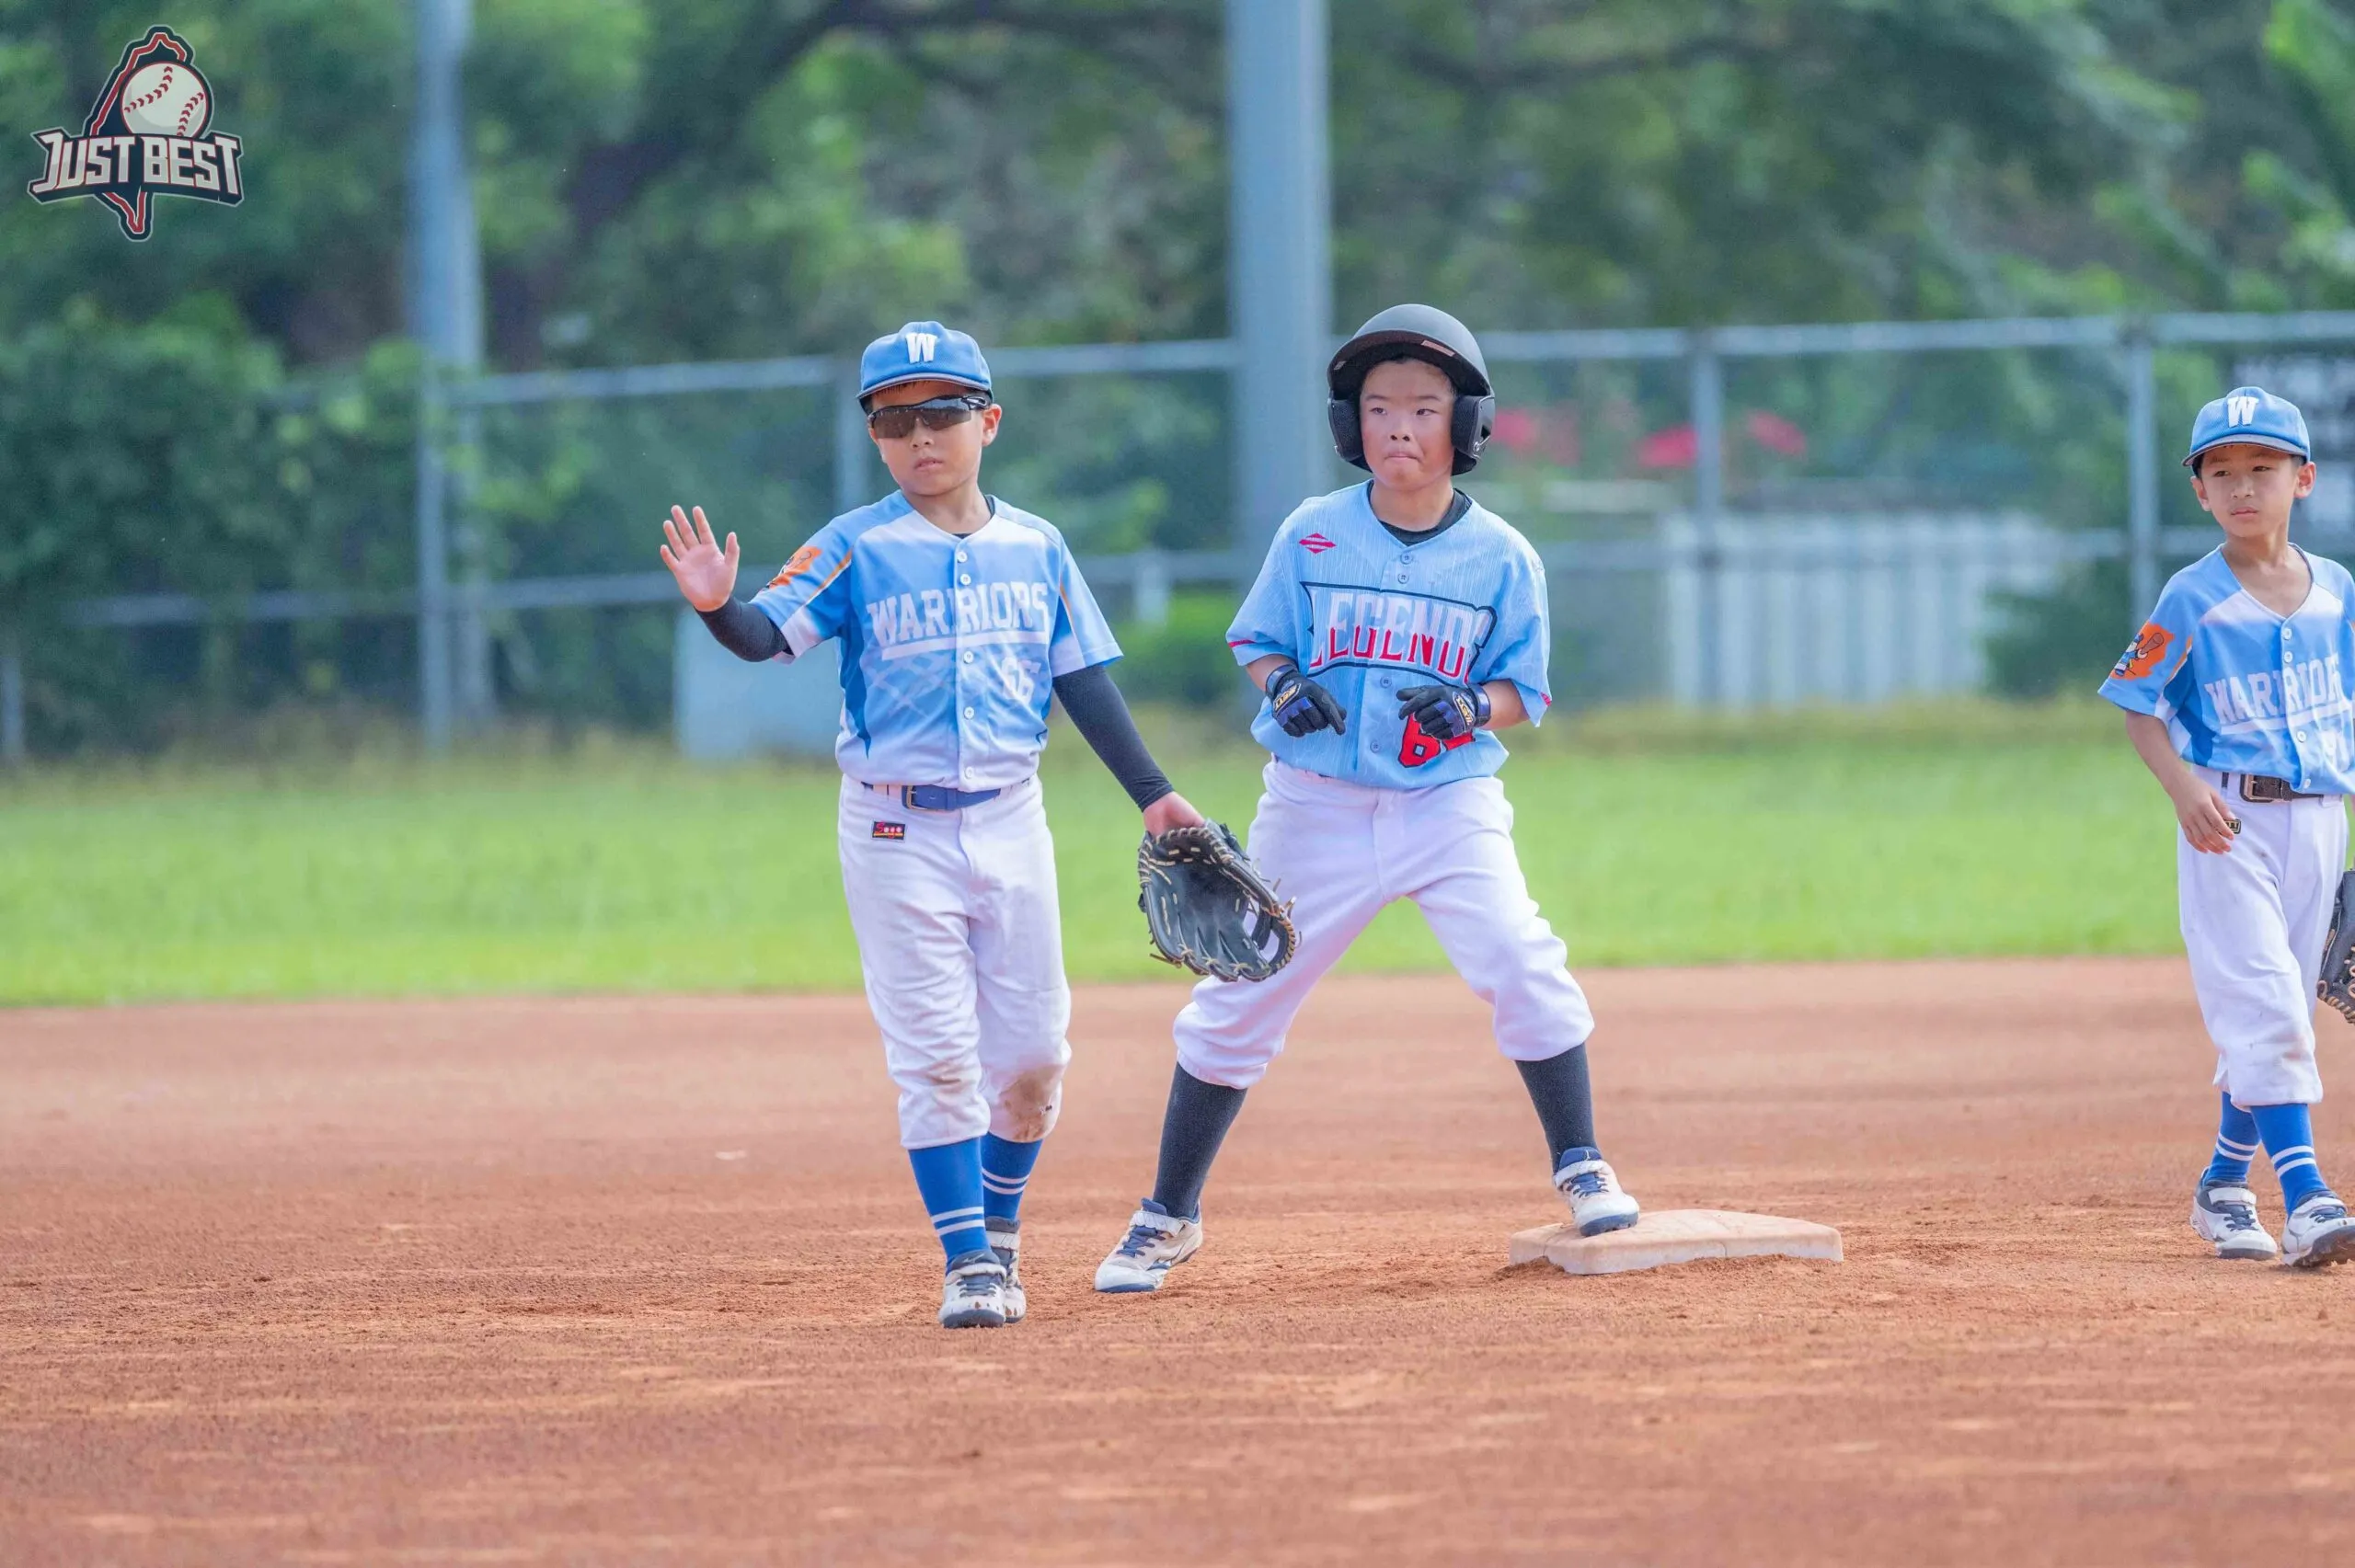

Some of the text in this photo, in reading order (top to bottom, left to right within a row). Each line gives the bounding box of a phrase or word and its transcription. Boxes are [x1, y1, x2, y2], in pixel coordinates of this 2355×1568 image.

[905, 332, 937, 364] W
[2227, 395, 2259, 429] W
[866, 581, 1049, 648] WARRIORS
[2204, 652, 2342, 725] WARRIOR
[1397, 714, 1476, 768] 6
